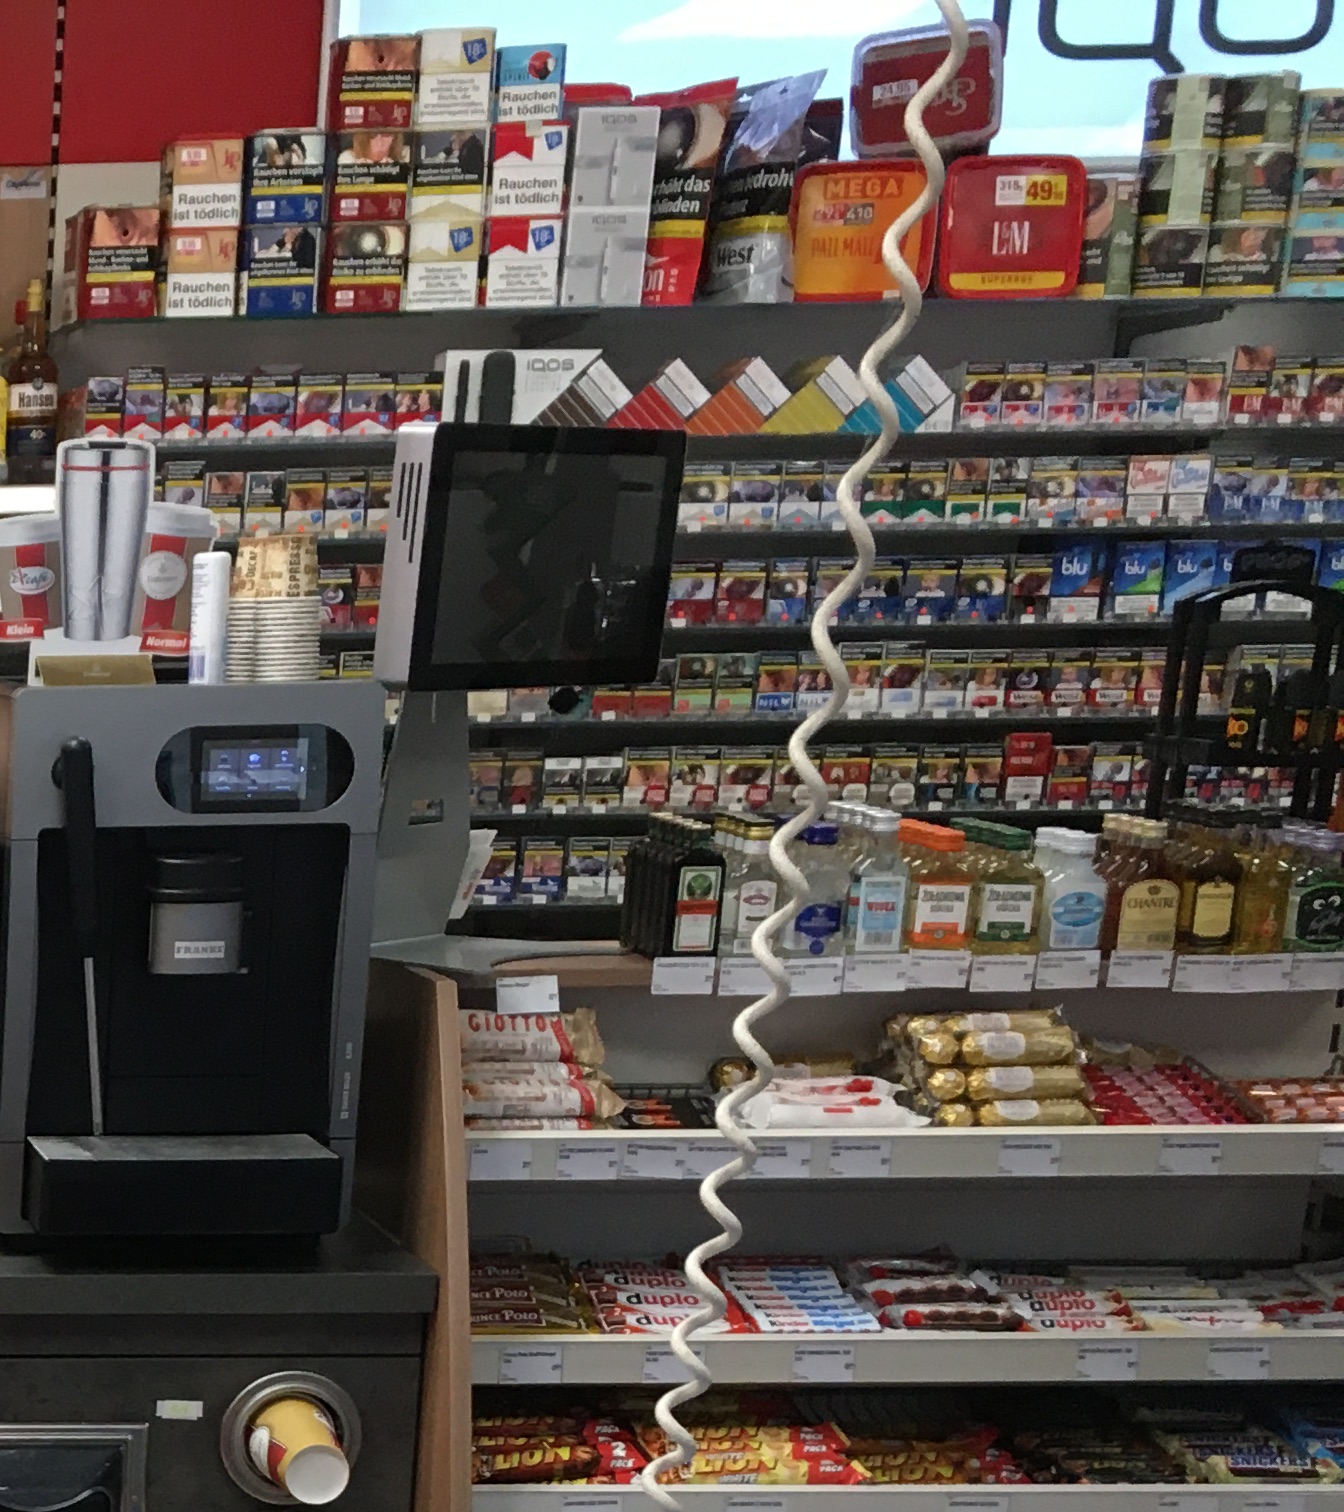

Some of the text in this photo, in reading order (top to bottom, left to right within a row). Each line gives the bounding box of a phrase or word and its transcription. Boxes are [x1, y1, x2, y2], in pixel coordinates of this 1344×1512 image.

[502, 91, 558, 103] Rauchen
[515, 103, 559, 117] tödlich
[498, 178, 558, 190] Rauchen
[684, 176, 711, 193] das
[825, 177, 901, 199] MEGA
[178, 192, 237, 206] Rauchen
[494, 191, 560, 205] ist tödlich
[173, 207, 240, 221] ist tödlich
[992, 220, 1031, 256] L&M
[716, 244, 754, 268] West
[171, 281, 231, 295] Rauchen
[168, 295, 234, 309] ist tödlich
[526, 357, 575, 372] IQOS
[1061, 557, 1089, 576] blu
[1124, 561, 1146, 575] blu
[1177, 559, 1199, 574] blu
[6, 624, 35, 636] Klein
[146, 635, 187, 649] Normal
[467, 1012, 548, 1033] GIOTTO
[614, 1274, 686, 1289] duplo
[625, 1290, 700, 1308] duplo
[1030, 1299, 1096, 1317] duplo
[1039, 1316, 1106, 1331] duplo
[611, 1441, 627, 1458] 2
[493, 1447, 571, 1472] LION
[1231, 1455, 1311, 1468] SNICKERS
